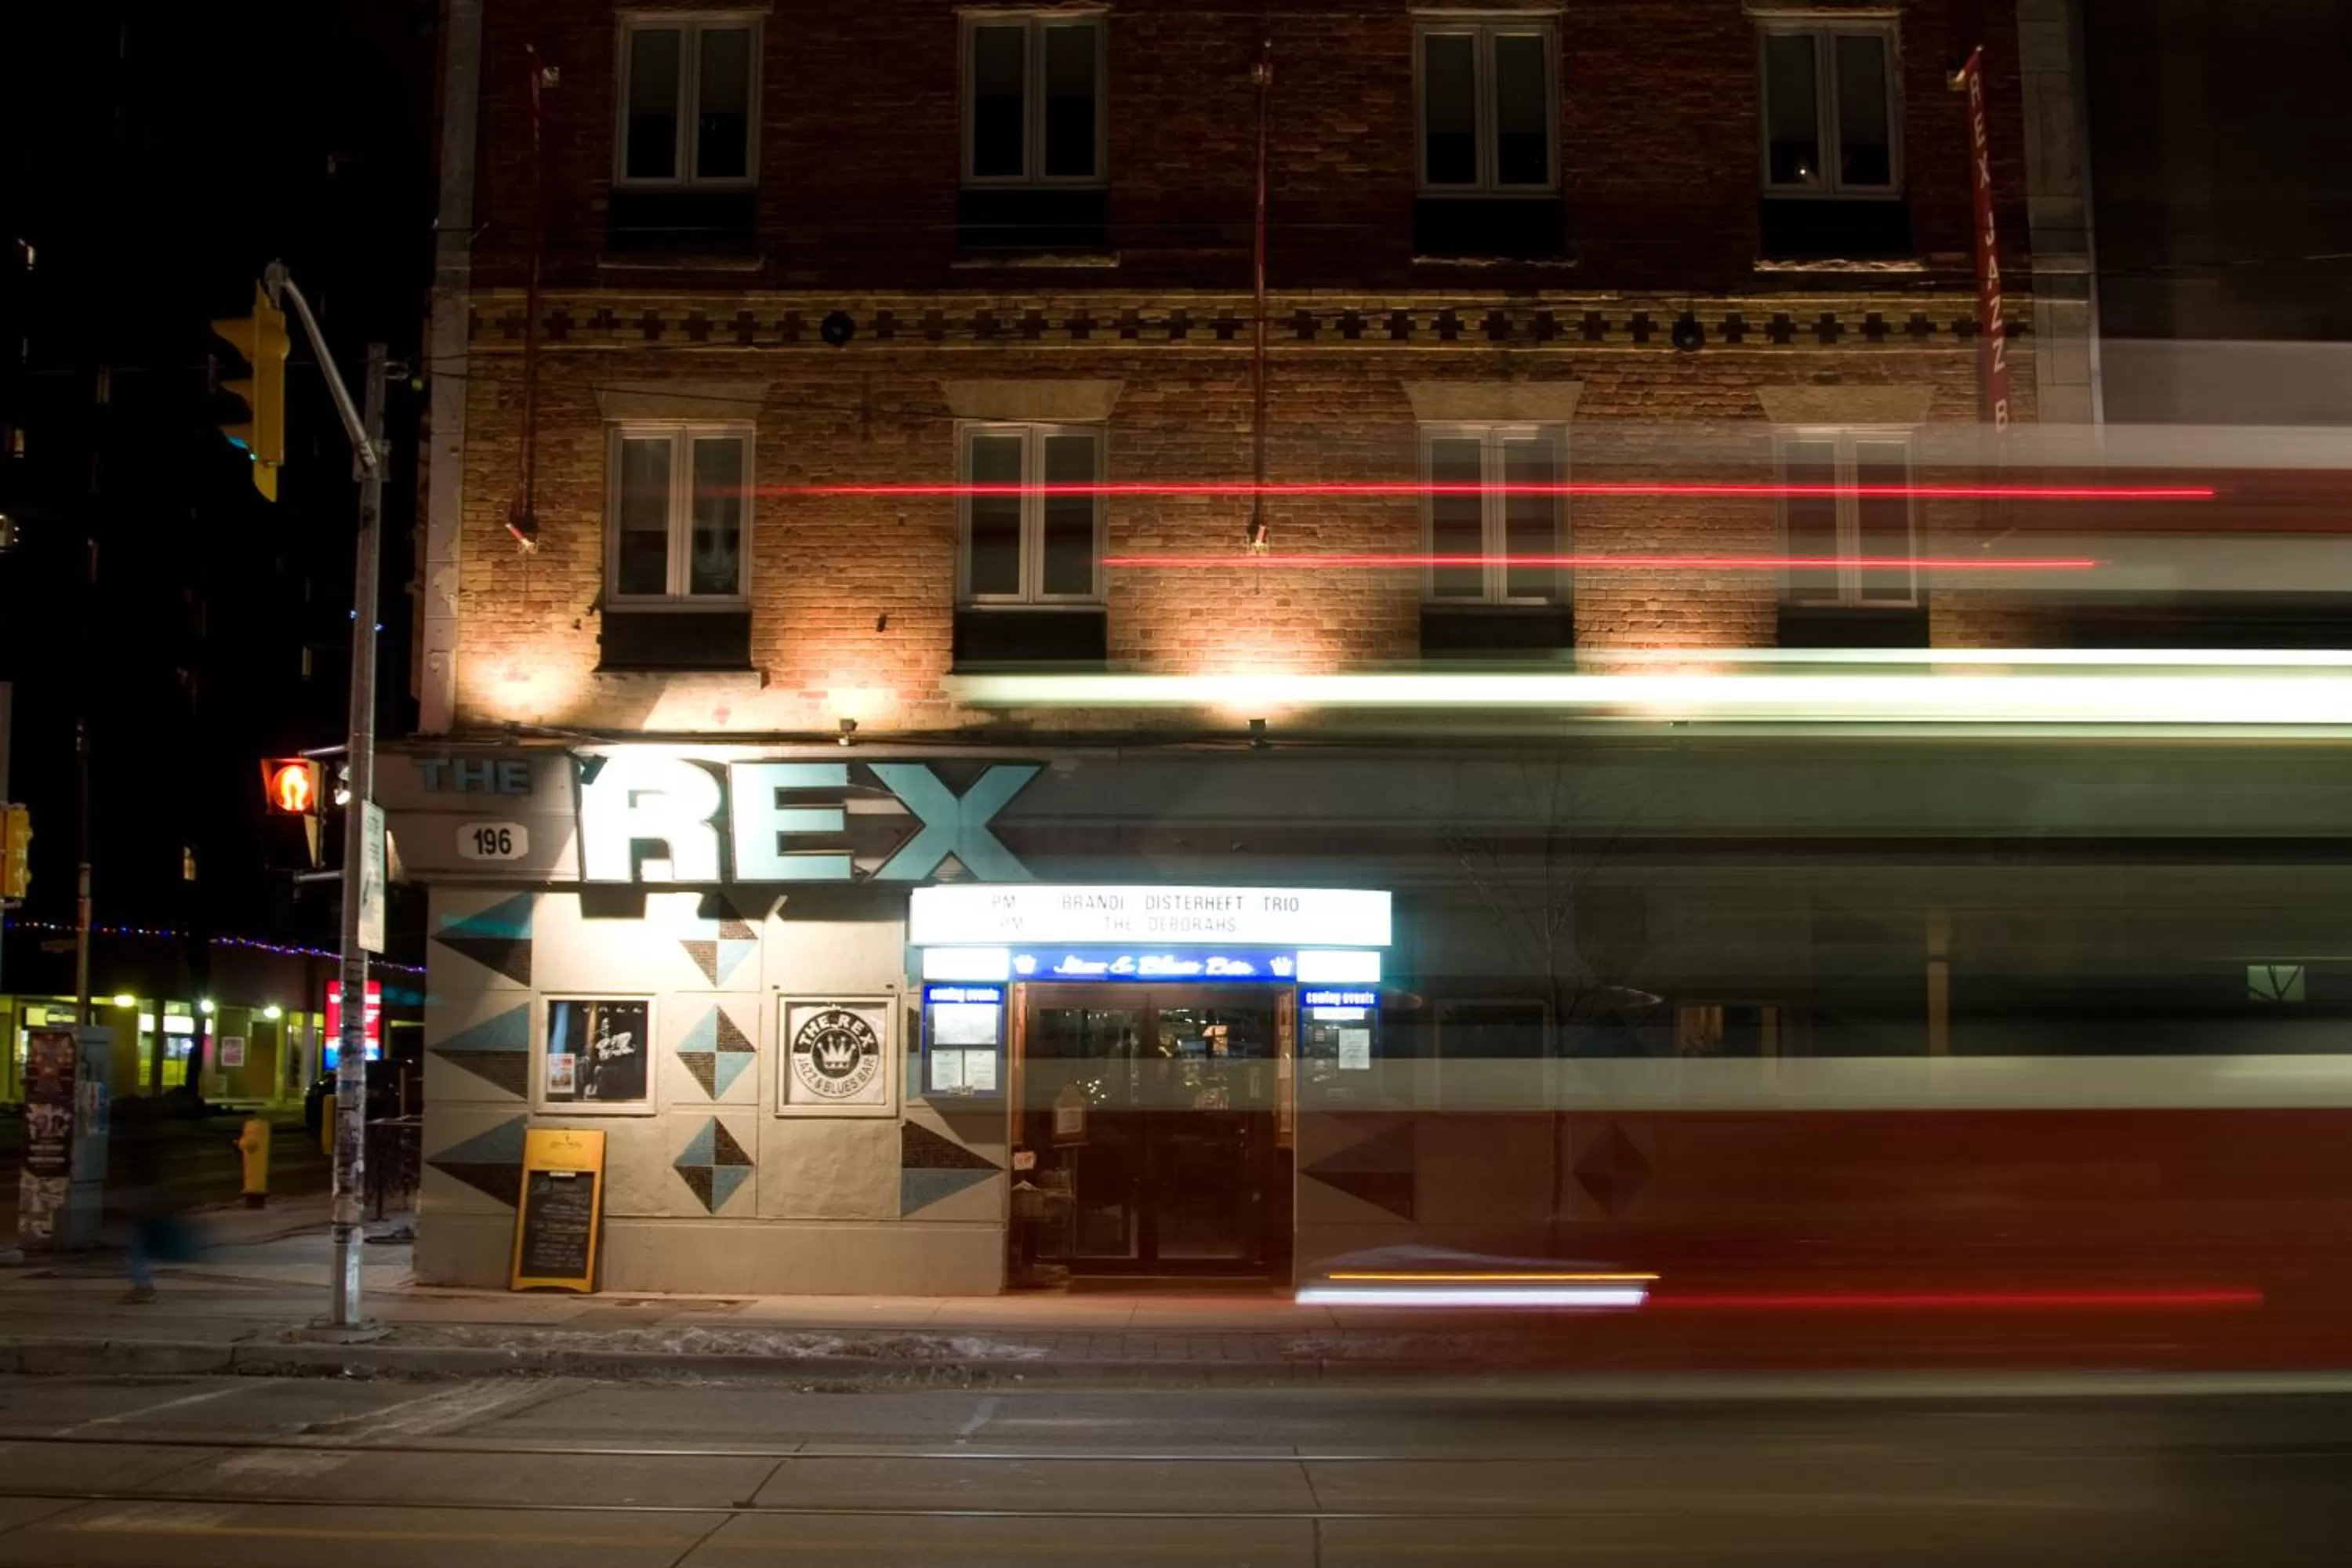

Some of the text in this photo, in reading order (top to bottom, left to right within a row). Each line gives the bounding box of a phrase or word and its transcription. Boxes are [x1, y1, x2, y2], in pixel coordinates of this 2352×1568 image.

[1969, 72, 1990, 189] REX
[1985, 212, 2005, 373] JAZZ
[416, 757, 1043, 881] THE REX
[473, 828, 512, 855] 196
[1062, 894, 1124, 910] BRANDI
[1145, 894, 1244, 911] DISTERHEFT
[1263, 895, 1300, 912] TRIO
[1103, 916, 1133, 931] THE
[1149, 916, 1238, 932] DEBORAHS
[798, 1014, 875, 1047] THE REX
[798, 1058, 817, 1083] JAZZ
[823, 1077, 859, 1094] BLUES
[857, 1058, 876, 1083] BAR
